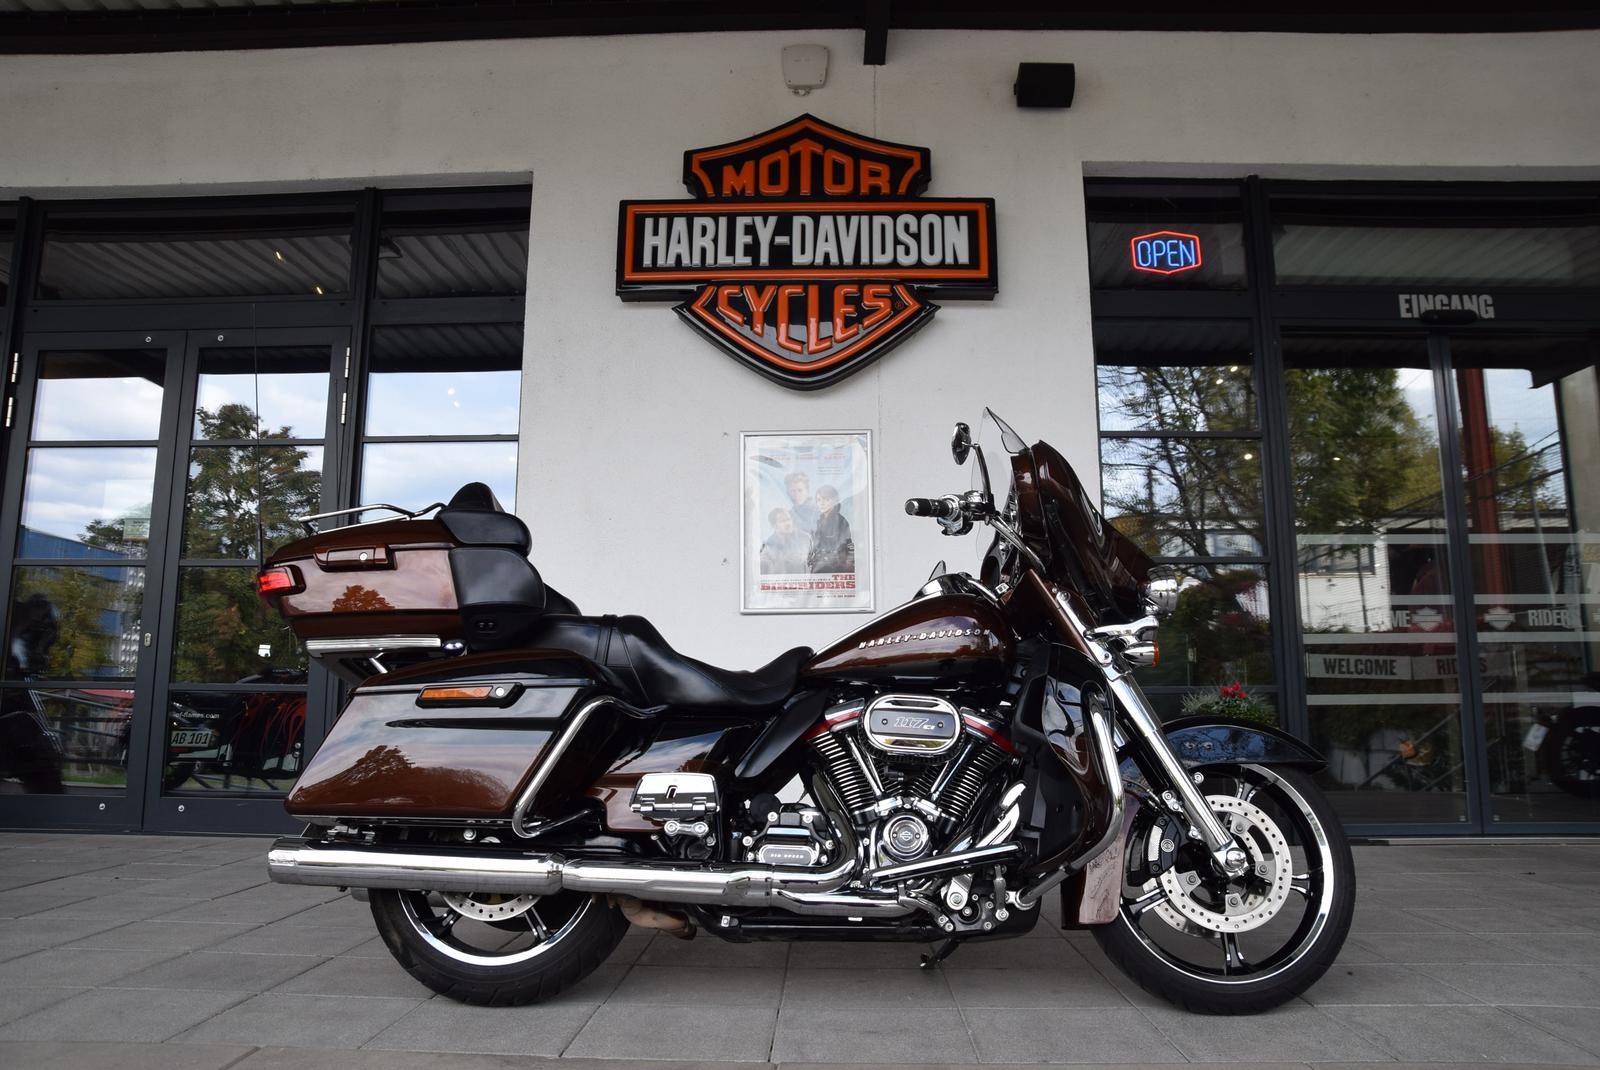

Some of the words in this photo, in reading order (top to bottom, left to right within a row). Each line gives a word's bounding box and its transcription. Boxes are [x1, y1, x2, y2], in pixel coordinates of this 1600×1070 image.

[721, 138, 891, 196] MOTOR
[642, 213, 970, 268] HARLEY-DAVIDSON
[1137, 240, 1196, 267] OPEN
[716, 284, 892, 354] CYCLES
[1398, 294, 1495, 318] EINGANG
[859, 629, 990, 649] HARLEY-DAVIDSON
[1323, 657, 1397, 676] WELCOME
